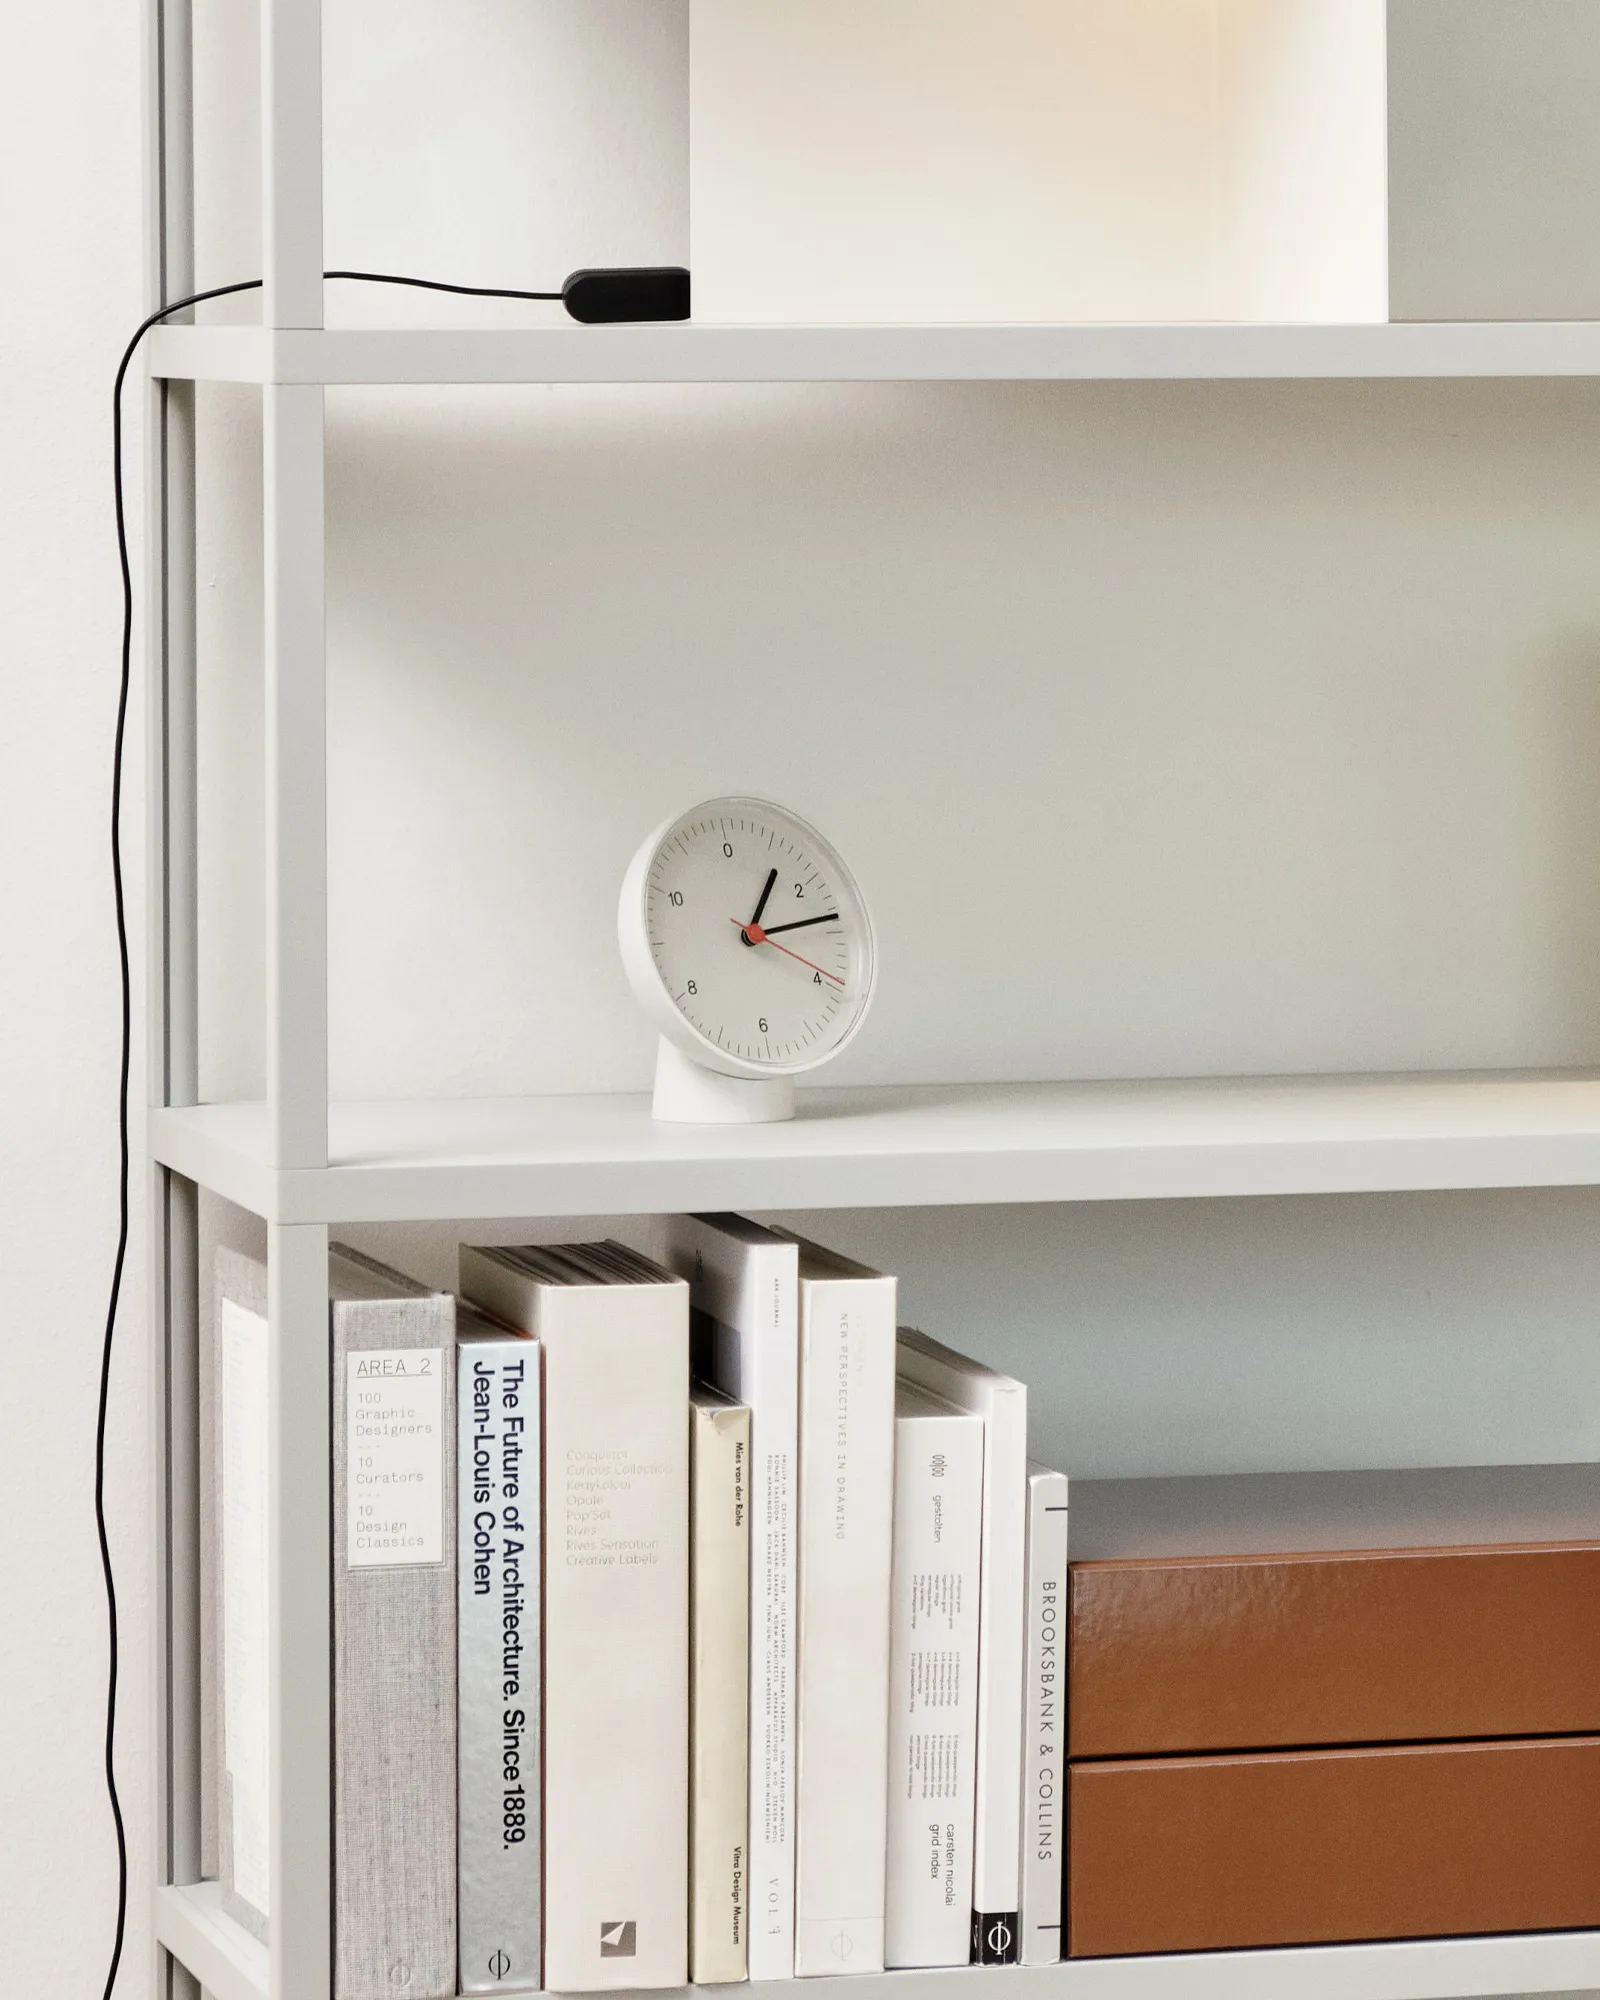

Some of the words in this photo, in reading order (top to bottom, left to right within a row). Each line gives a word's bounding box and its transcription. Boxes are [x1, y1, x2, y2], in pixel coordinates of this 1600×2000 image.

[723, 843, 733, 858] 0
[668, 891, 683, 907] 10
[794, 884, 805, 899] 2
[688, 980, 698, 996] 8
[813, 971, 822, 986] 4
[758, 1018, 769, 1033] 6
[840, 1312, 848, 1339] NEW
[357, 1359, 406, 1376] AREA
[420, 1358, 432, 1374] 2
[502, 1359, 524, 1408] The
[358, 1393, 381, 1404] 100
[838, 1346, 848, 1447] PERSPECTIVES
[356, 1408, 415, 1421] Graphic
[356, 1423, 433, 1437] Designers
[473, 1361, 496, 1504] Jean-Louis
[358, 1457, 373, 1468] 10
[502, 1417, 524, 1498] Future
[735, 1442, 744, 1464] Mies
[837, 1454, 846, 1469] IN
[356, 1472, 424, 1484] Curators
[735, 1486, 744, 1501] der
[358, 1506, 373, 1516] 10
[502, 1506, 525, 1532] of
[735, 1503, 744, 1527] Rohe
[836, 1477, 846, 1540] DRAWING
[356, 1521, 407, 1533] Design
[356, 1537, 424, 1549] Classics
[473, 1511, 496, 1595] Cohen
[567, 1540, 597, 1551] Rives
[600, 1538, 658, 1551] Sensation
[566, 1555, 615, 1566] Creative
[620, 1553, 658, 1565] Labels
[502, 1538, 525, 1701] Architecture.
[1040, 1581, 1056, 1732] BROOKSBANK
[502, 1709, 526, 1781] Since
[1039, 1744, 1054, 1756] &
[502, 1783, 526, 1850] 1889.
[1038, 1768, 1054, 1860] COLLINS
[928, 1824, 942, 1846] grid
[946, 1823, 956, 1866] carsten
[733, 1846, 742, 1868] Vitra
[930, 1849, 941, 1880] index
[731, 1871, 742, 1903] Design
[768, 1878, 779, 1916] VOL
[945, 1870, 956, 1906] nicolai
[733, 1906, 742, 1945] Museum
